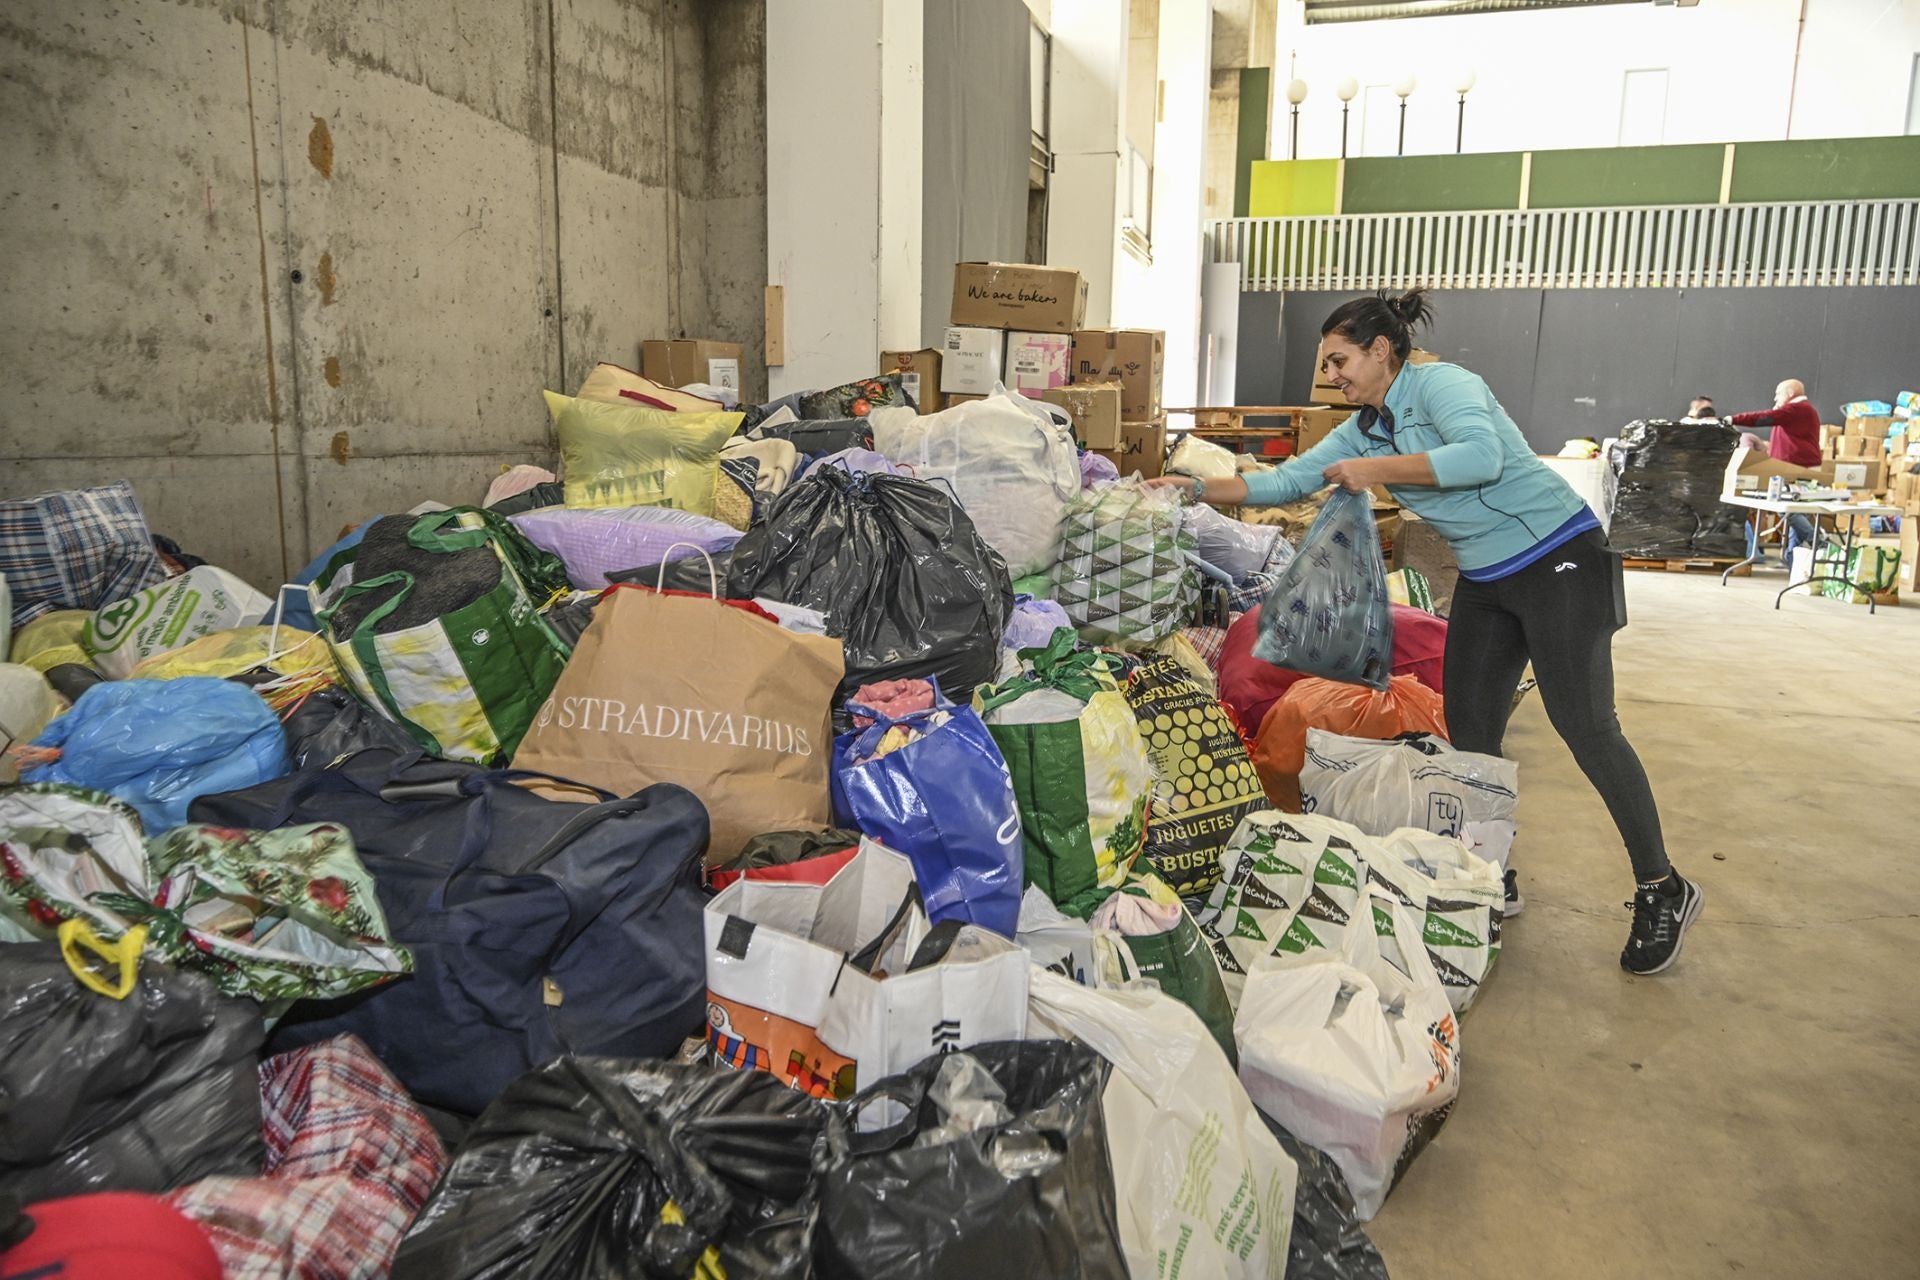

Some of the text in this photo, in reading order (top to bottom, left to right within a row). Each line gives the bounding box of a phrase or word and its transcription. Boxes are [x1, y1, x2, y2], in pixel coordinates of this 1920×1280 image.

[968, 283, 990, 299] We
[992, 290, 1015, 300] are
[1018, 288, 1057, 304] bakers
[1163, 697, 1195, 710] GRACIAS
[557, 695, 813, 756] STRADIVARIUS
[1156, 813, 1235, 844] JUGUETES
